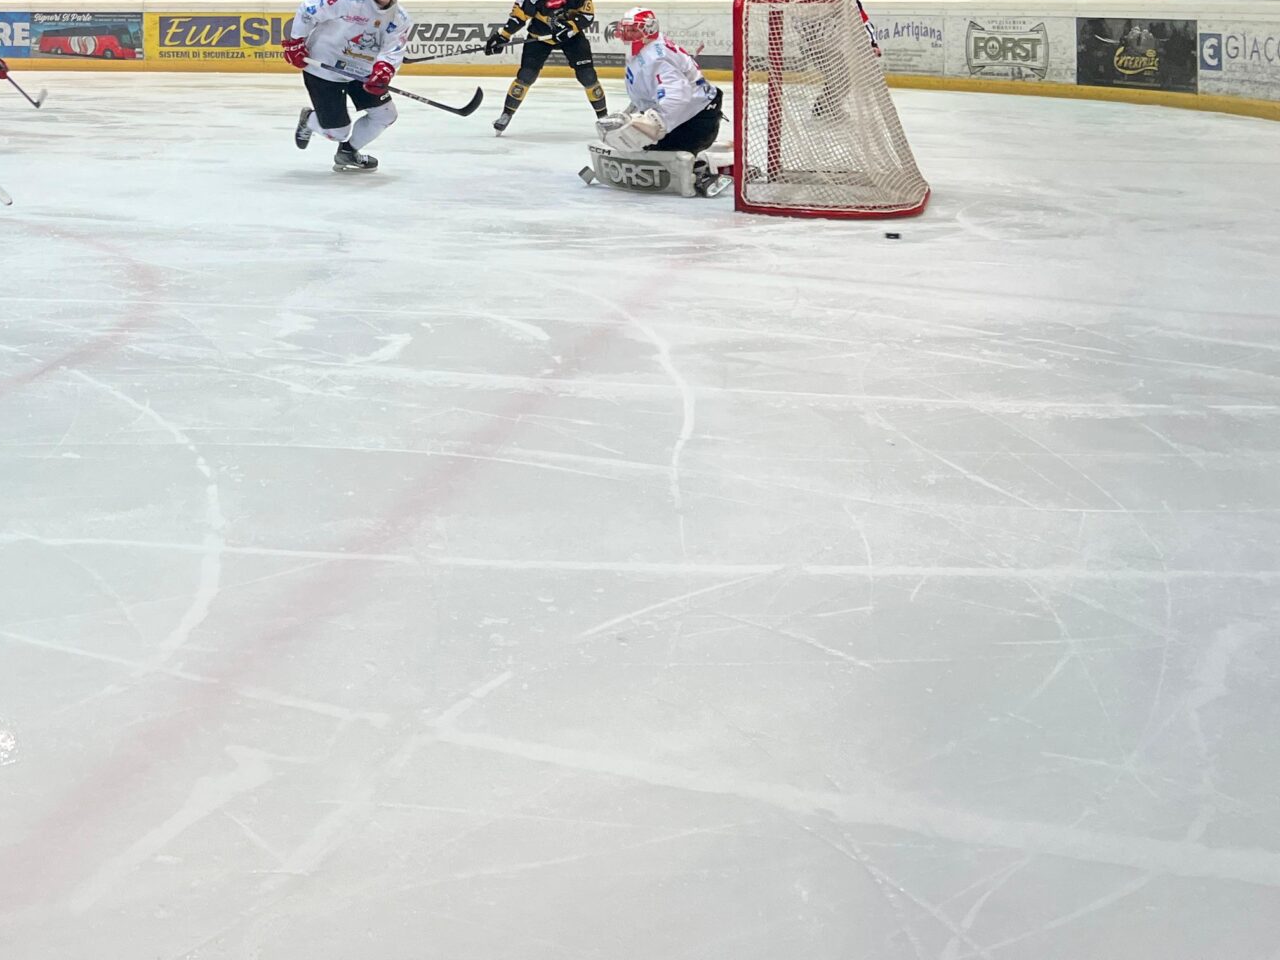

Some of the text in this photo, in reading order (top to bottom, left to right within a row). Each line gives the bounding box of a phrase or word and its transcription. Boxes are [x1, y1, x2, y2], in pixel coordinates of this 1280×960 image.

[407, 23, 505, 42] ROSAT
[892, 21, 943, 43] Artigiana
[159, 50, 190, 59] SISTEMI
[192, 50, 201, 59] DI
[203, 50, 245, 59] SICUREZZA
[973, 36, 1042, 63] FORST
[1225, 33, 1280, 62] GIAC
[589, 145, 612, 156] CCM
[601, 157, 668, 189] FORST
